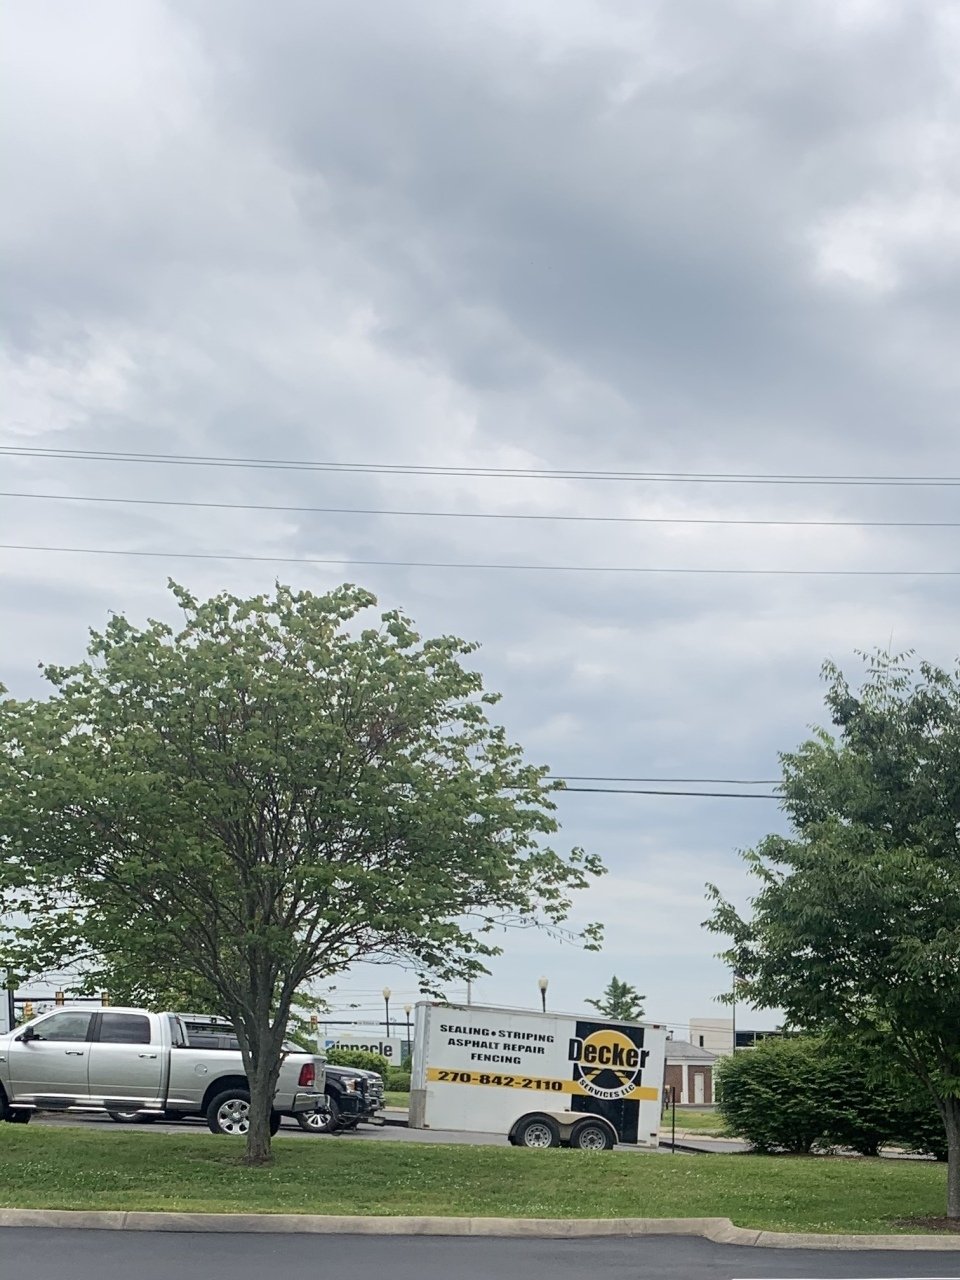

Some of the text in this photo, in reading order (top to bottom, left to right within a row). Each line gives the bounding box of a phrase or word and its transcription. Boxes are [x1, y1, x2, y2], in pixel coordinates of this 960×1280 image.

[498, 1030, 555, 1043] STRIPING
[448, 1038, 545, 1055] ASPHALT REPAIR
[568, 1038, 650, 1069] Decker
[471, 1053, 521, 1064] FENCING
[438, 1071, 563, 1091] 270-842-2110
[580, 1080, 620, 1098] SERVICES
